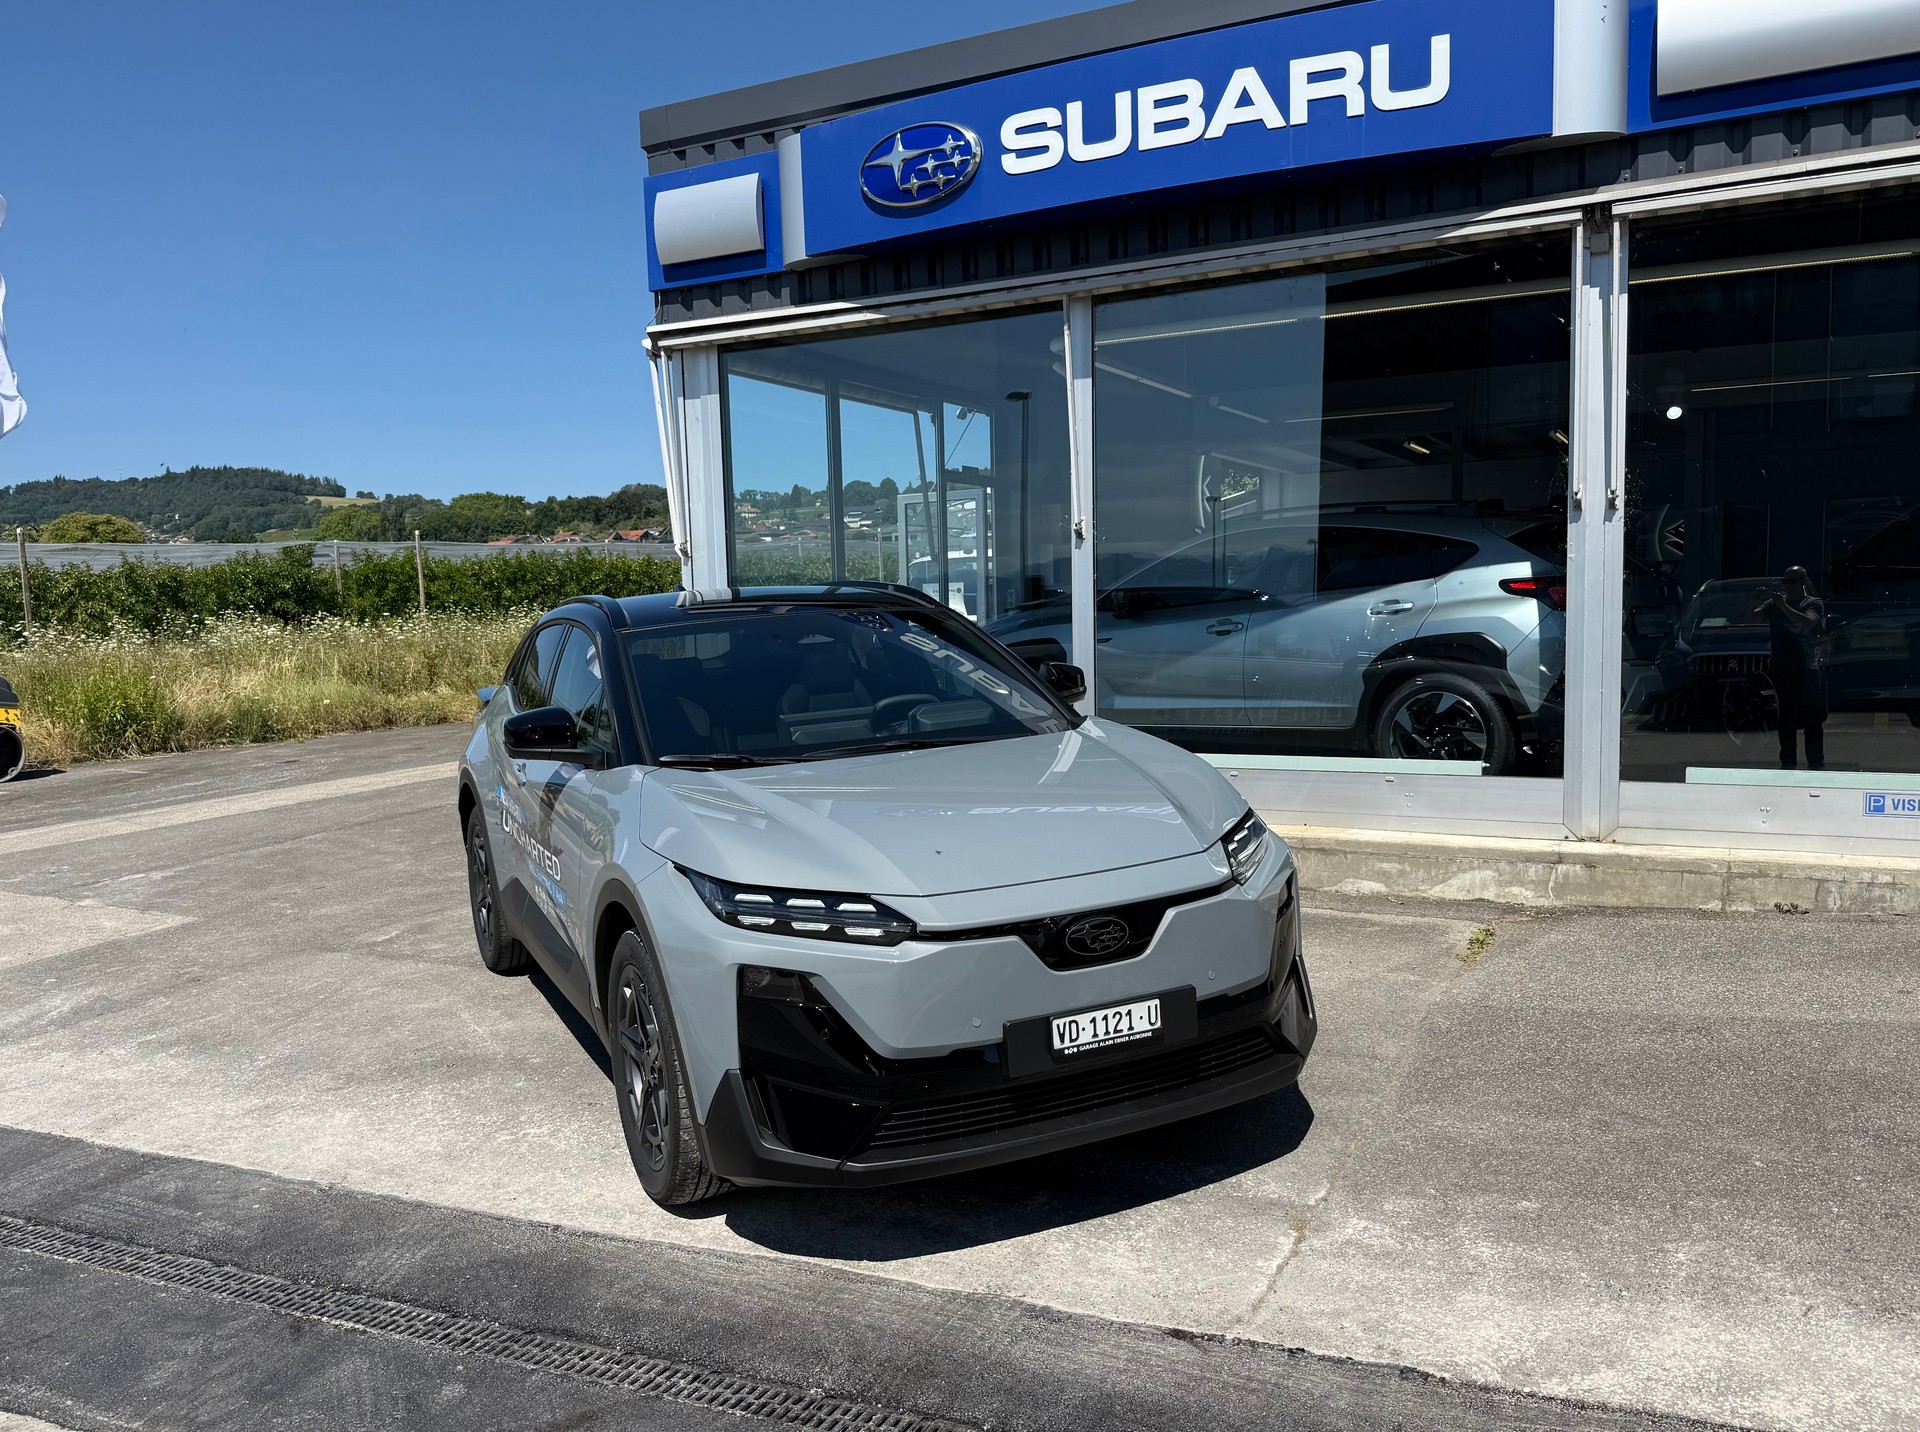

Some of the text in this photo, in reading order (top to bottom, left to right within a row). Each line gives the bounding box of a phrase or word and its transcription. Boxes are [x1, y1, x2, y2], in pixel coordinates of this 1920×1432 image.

[1000, 34, 1451, 174] SUBARU
[1870, 797, 1884, 811] P
[503, 809, 561, 881] UNCHARTED
[1079, 1043, 1099, 1051] GARAGE
[1100, 1040, 1114, 1048] ALAIN
